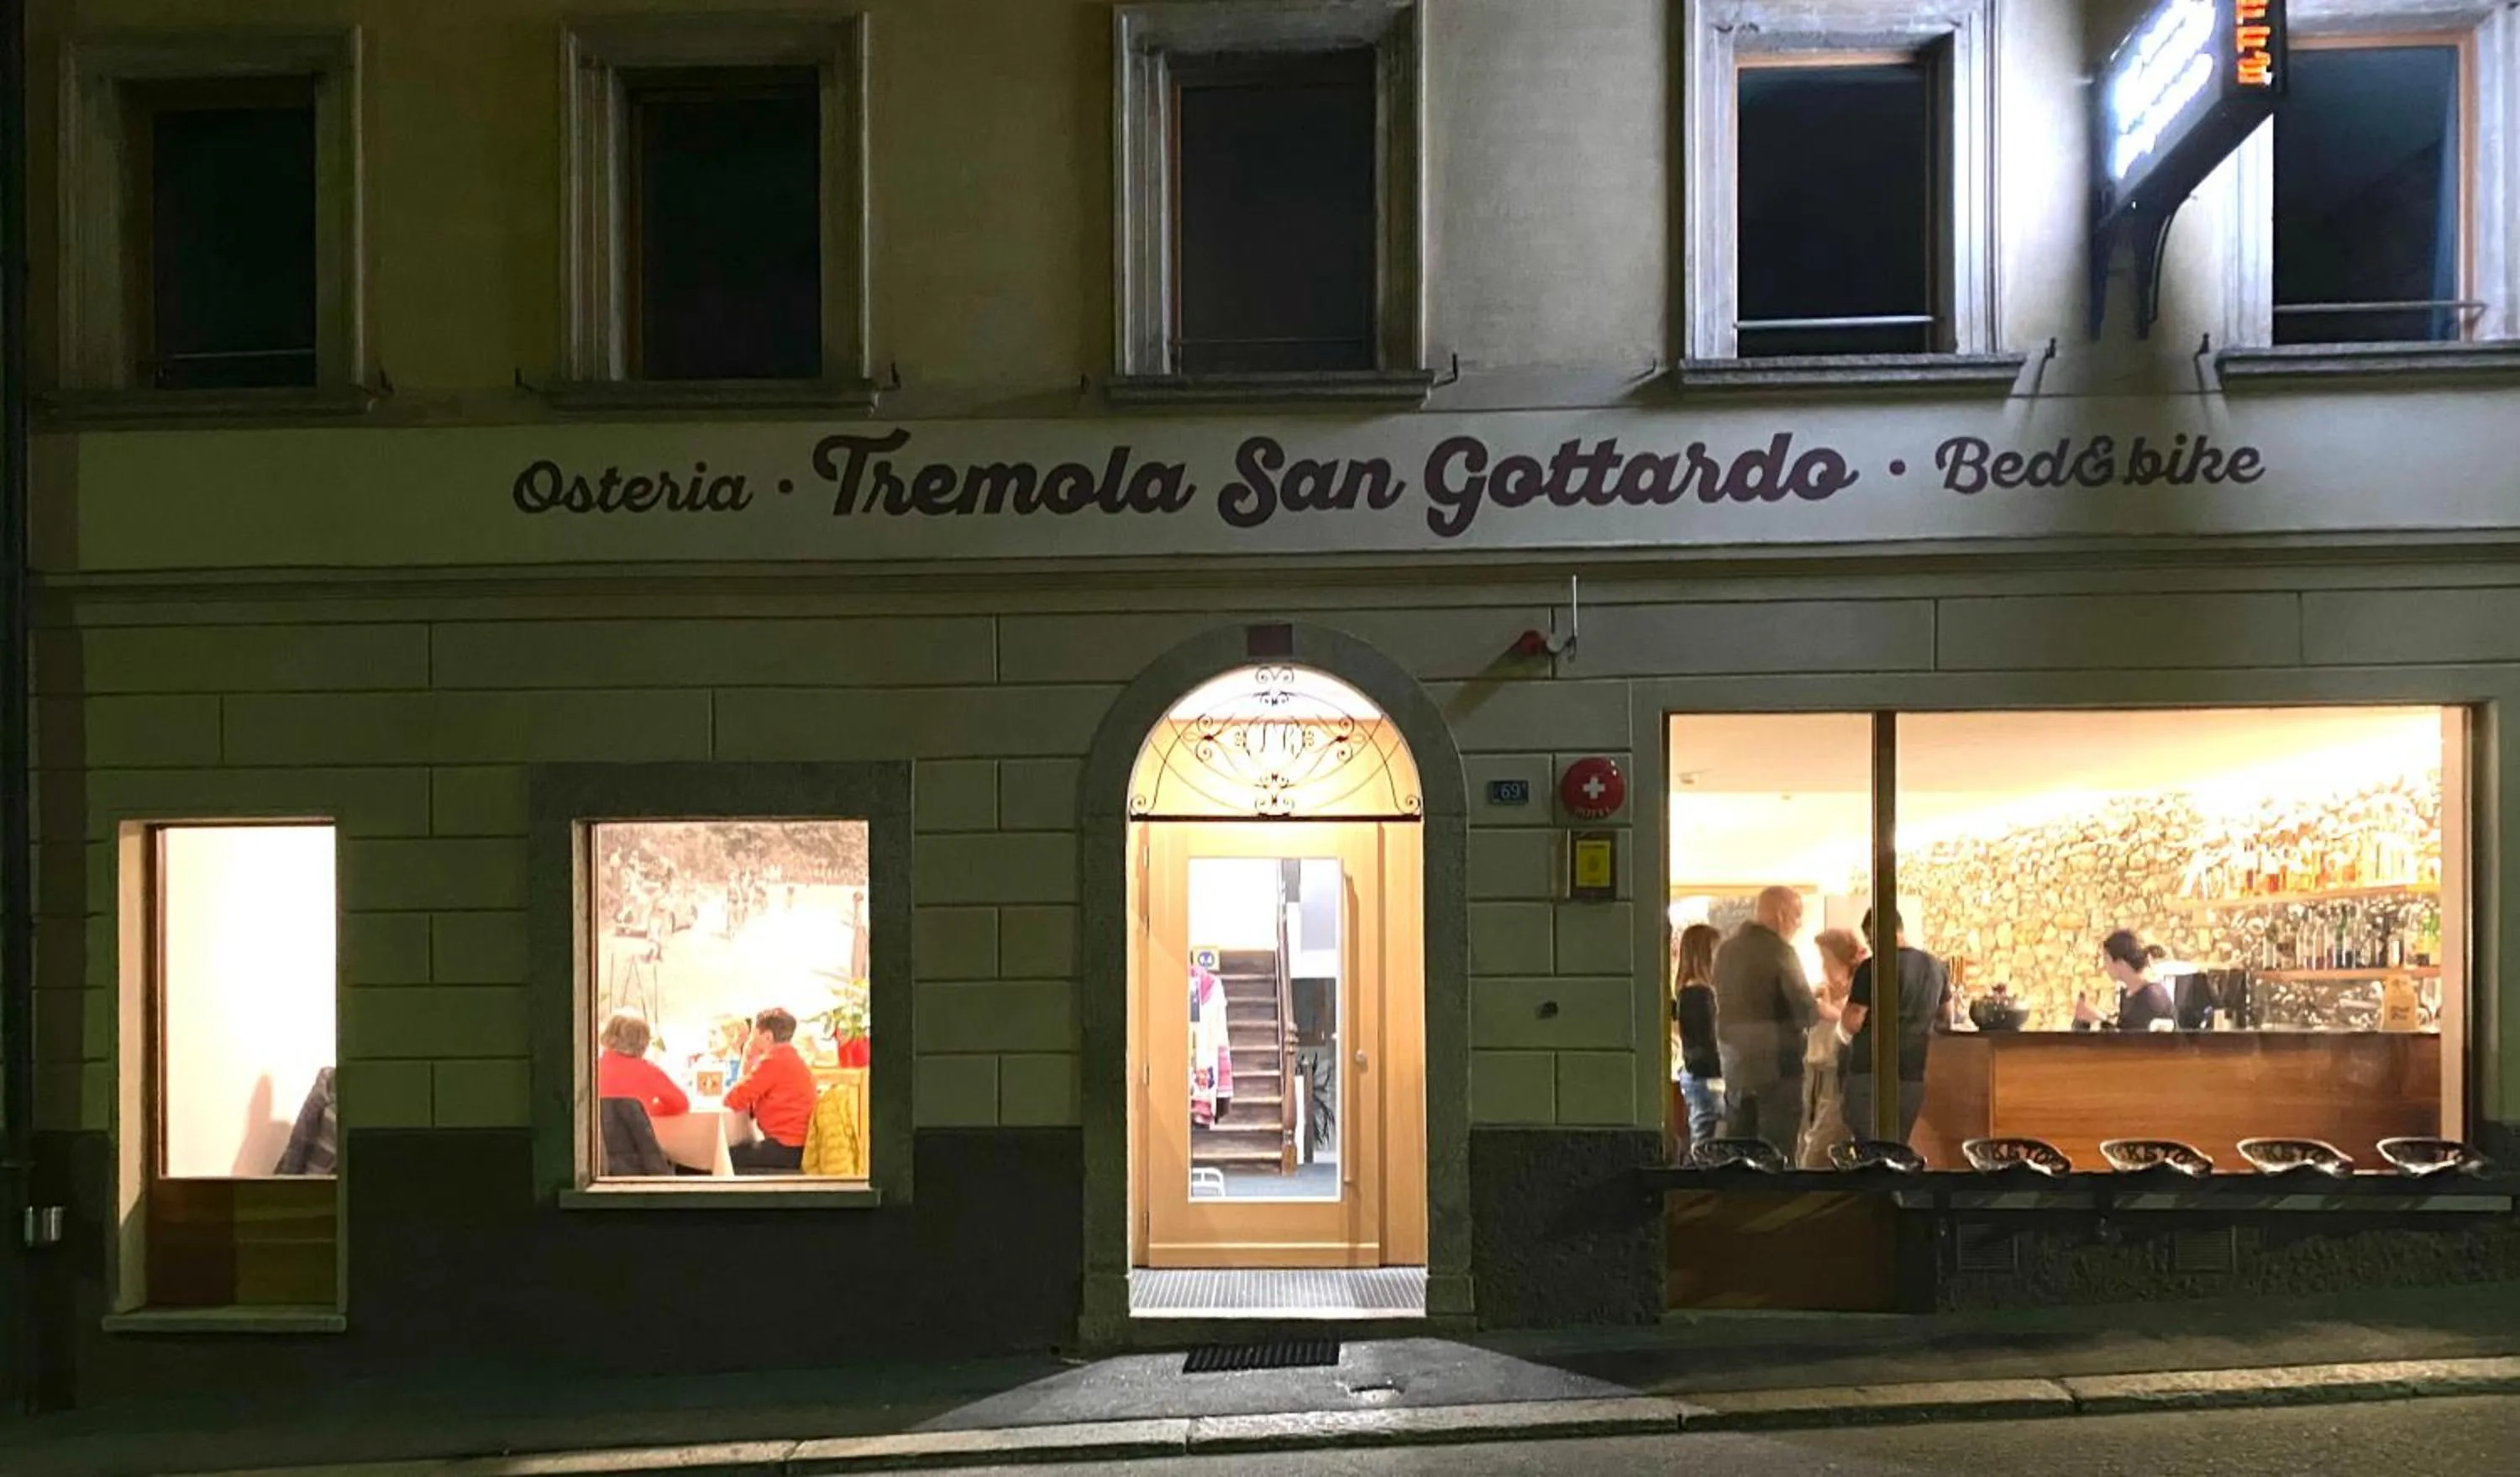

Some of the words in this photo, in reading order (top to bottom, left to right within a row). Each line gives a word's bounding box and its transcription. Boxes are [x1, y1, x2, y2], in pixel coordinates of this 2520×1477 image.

[512, 460, 754, 514] Osteria
[811, 427, 1198, 517] Tremola
[1216, 435, 1407, 528] San
[1423, 432, 1860, 539] Gottardo
[1500, 782, 1521, 800] 69
